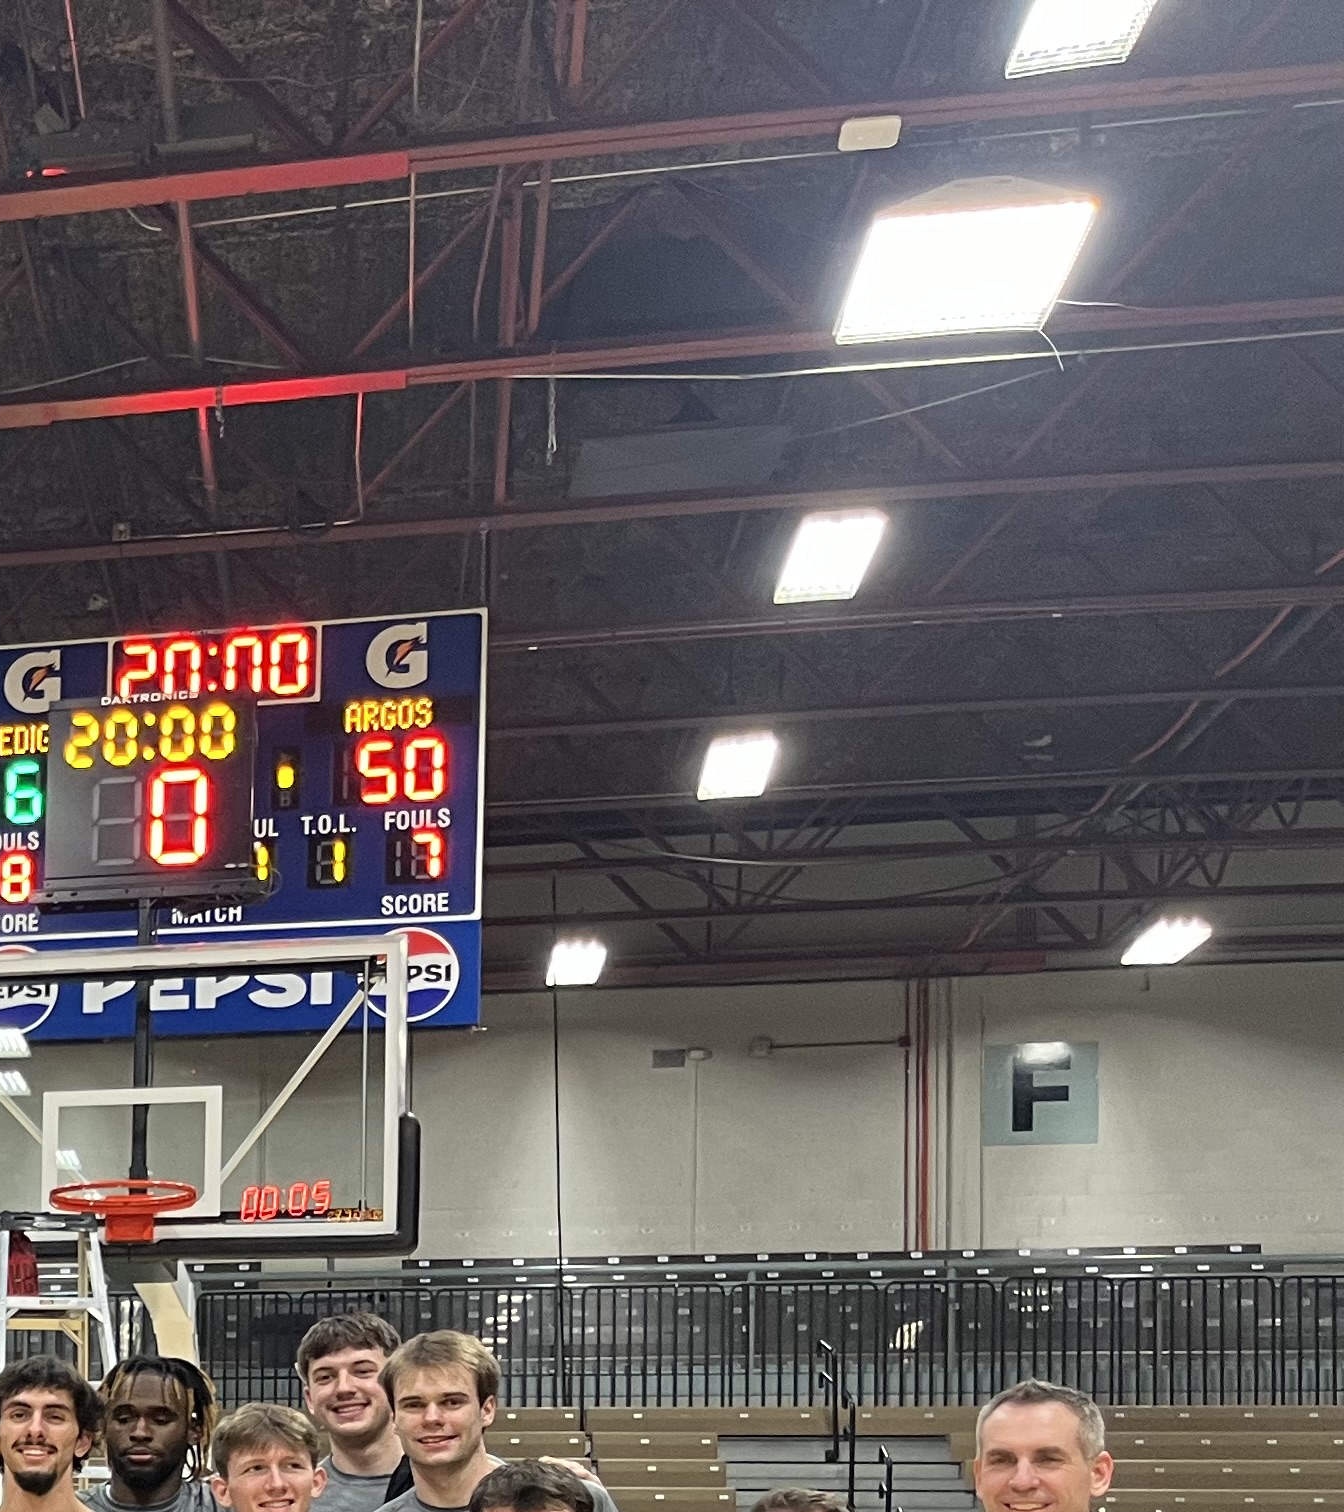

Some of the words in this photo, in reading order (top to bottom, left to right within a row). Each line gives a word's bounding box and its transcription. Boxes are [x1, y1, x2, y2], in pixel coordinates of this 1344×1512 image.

[101, 690, 199, 707] DAKTRONICS
[343, 696, 434, 733] ARGOS
[64, 703, 236, 769] 20:00
[358, 737, 446, 804] 50
[5, 760, 43, 824] 6
[253, 818, 279, 838] UL
[301, 814, 357, 835] T.O.L.
[384, 808, 451, 831] FOULS
[0, 853, 33, 903] 8
[381, 893, 449, 916] SCORE
[407, 963, 452, 983] PSI
[1012, 1052, 1070, 1132] F
